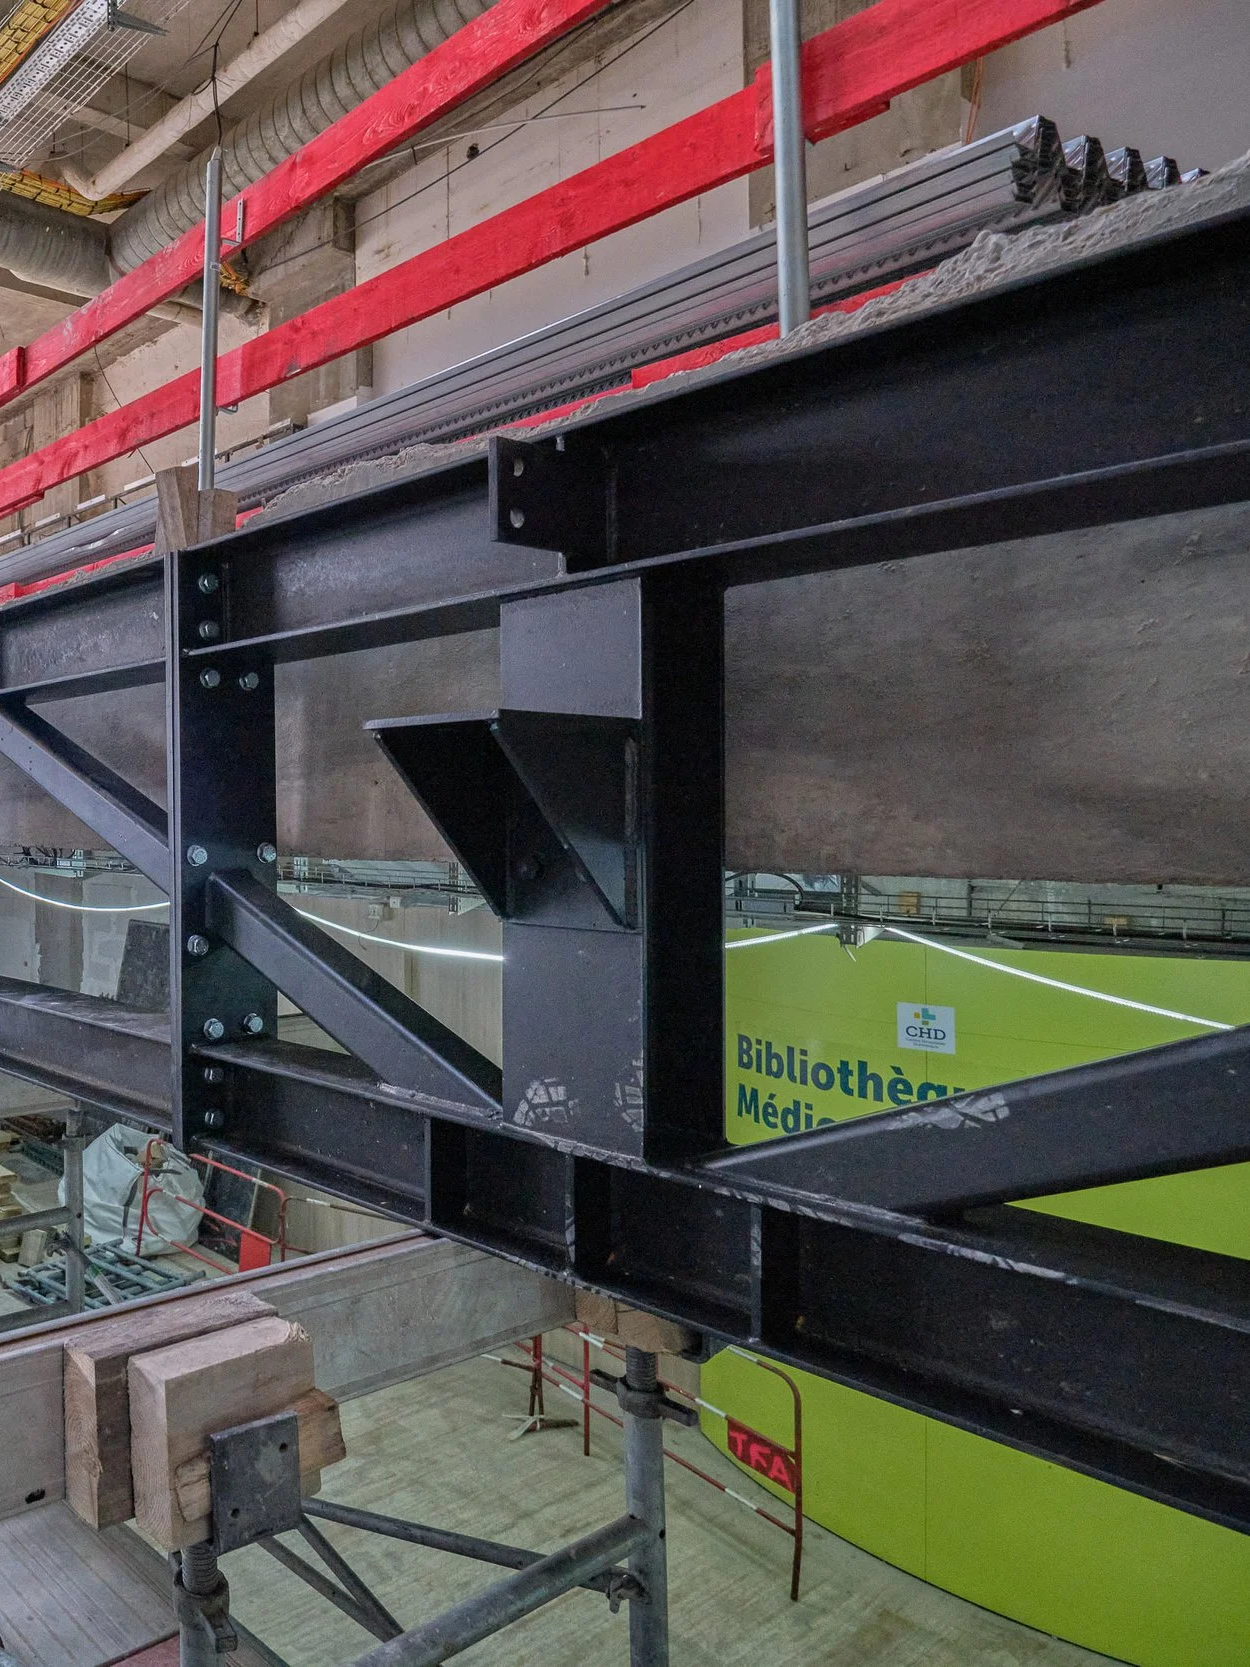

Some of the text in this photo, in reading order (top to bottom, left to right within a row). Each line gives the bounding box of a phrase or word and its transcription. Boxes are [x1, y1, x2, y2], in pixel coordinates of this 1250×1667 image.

[905, 1025, 947, 1041] CHD
[737, 1033, 965, 1107] Bibliothè
[737, 1083, 837, 1133] Médi
